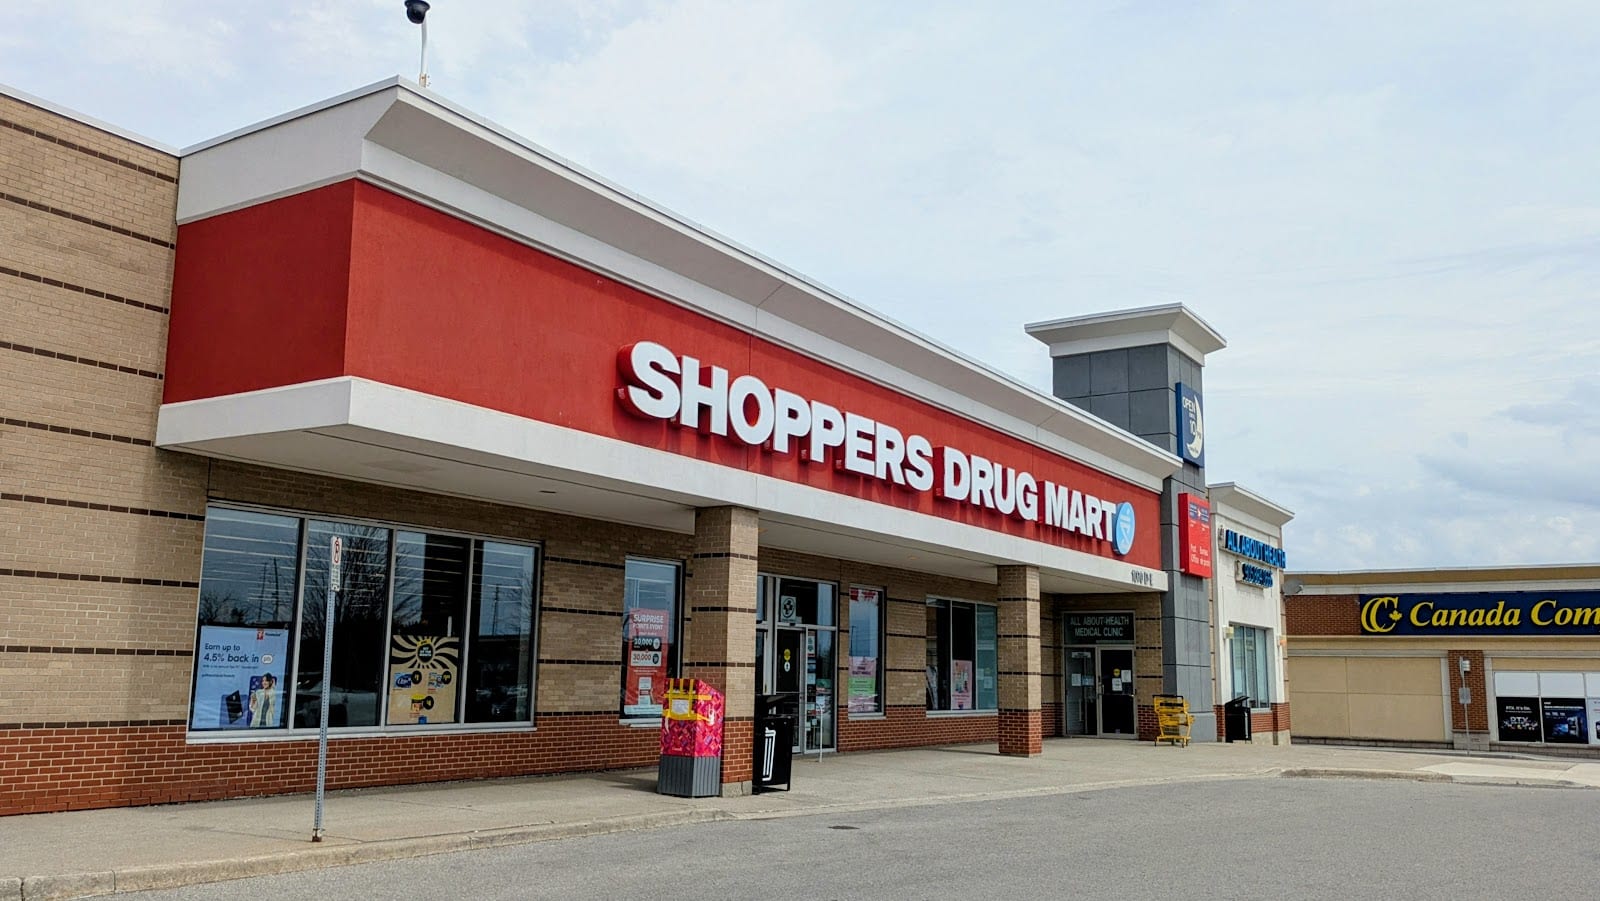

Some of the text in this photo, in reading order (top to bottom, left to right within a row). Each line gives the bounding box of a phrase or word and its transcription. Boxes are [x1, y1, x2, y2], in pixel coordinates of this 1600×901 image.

[1182, 396, 1196, 413] OPEN
[628, 341, 1116, 542] SHOPPERS DRUG MART
[1226, 529, 1287, 569] ALL ABOUT HEALTH
[1409, 601, 1521, 627] Canada
[1530, 599, 1600, 628] Com
[633, 614, 664, 624] SURPRISE
[1070, 616, 1081, 626] ALL
[1074, 627, 1124, 637] MEDICAL CLINIC
[204, 643, 220, 651] Earn
[203, 653, 225, 662] 4.5%
[227, 654, 250, 663] back
[251, 654, 260, 663] in
